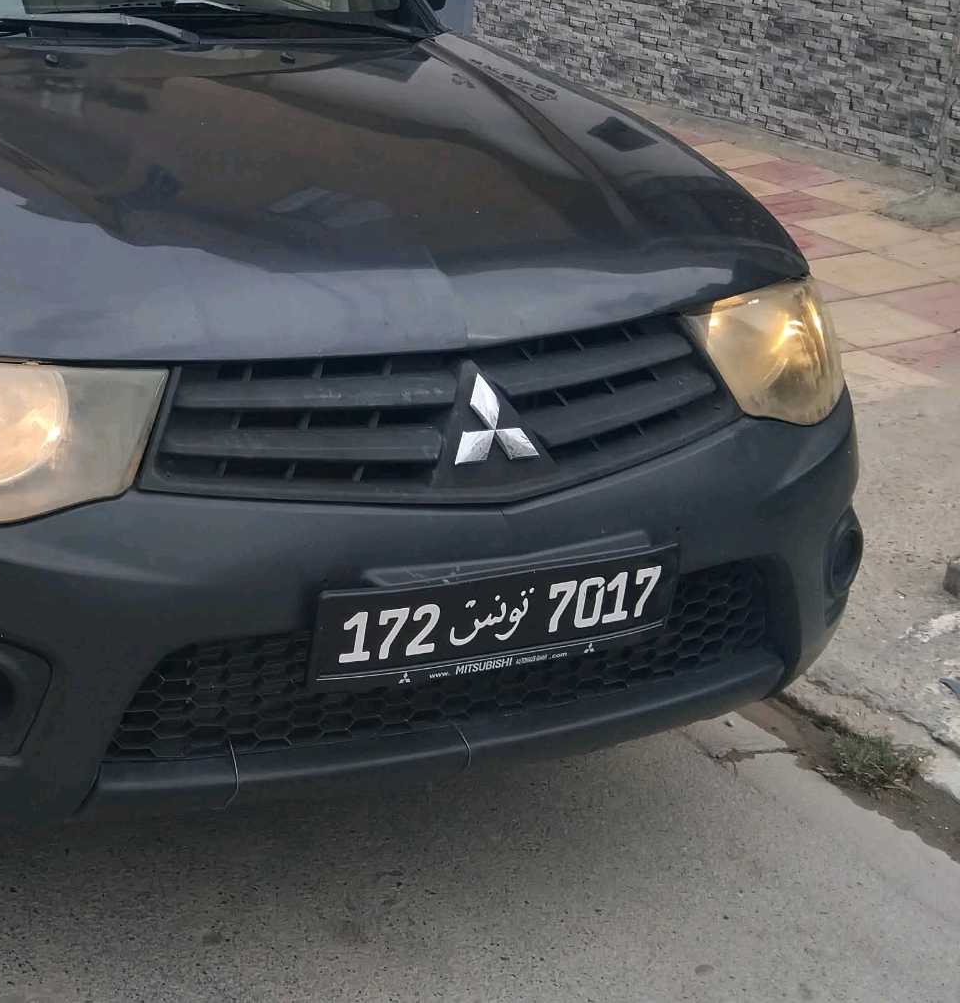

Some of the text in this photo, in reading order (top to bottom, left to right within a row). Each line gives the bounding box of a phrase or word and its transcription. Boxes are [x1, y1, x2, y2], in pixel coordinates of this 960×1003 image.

[338, 565, 662, 663] 172 تونس 7017
[455, 657, 513, 676] MITSUBISHI
